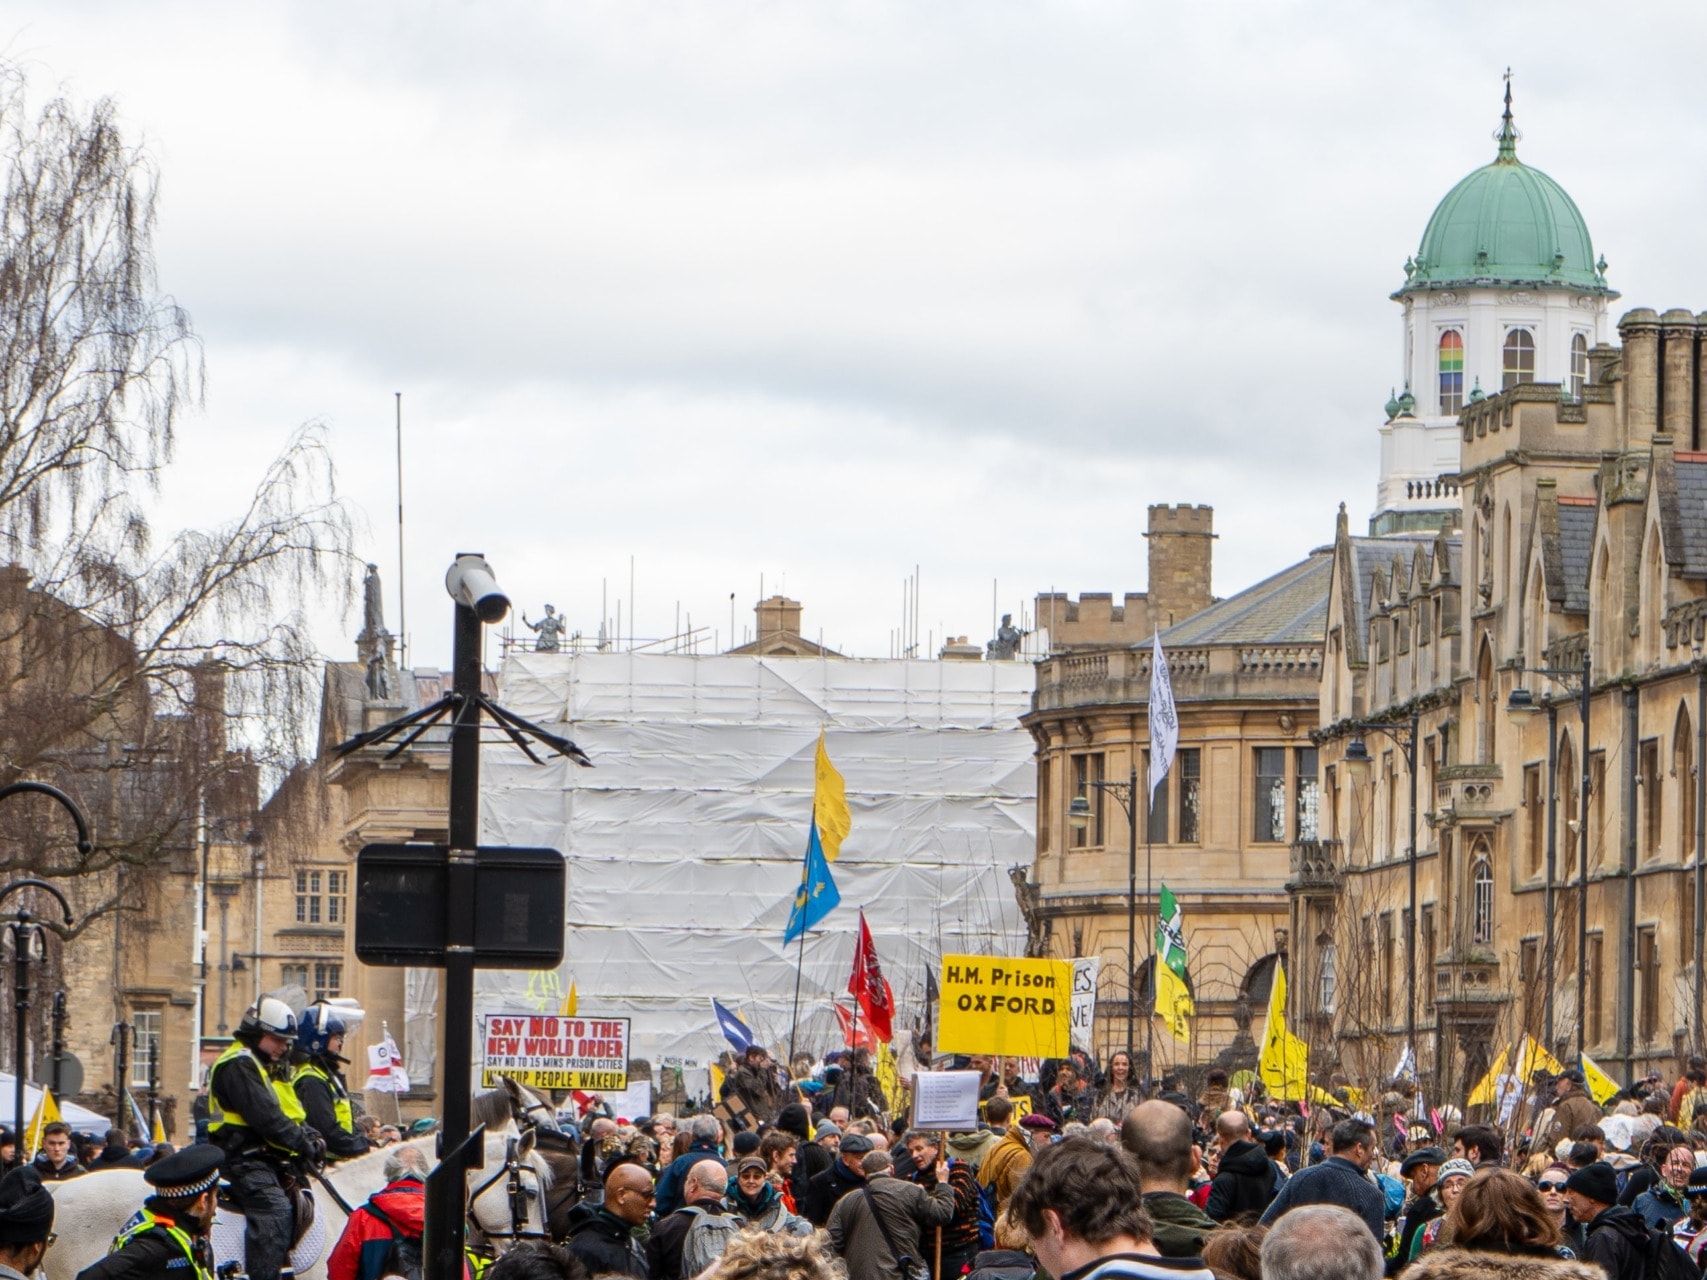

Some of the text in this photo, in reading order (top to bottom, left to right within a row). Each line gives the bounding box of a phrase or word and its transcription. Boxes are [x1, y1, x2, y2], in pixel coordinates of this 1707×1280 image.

[947, 966, 1055, 989] H.M. Prison
[958, 994, 1055, 1015] OXFORD
[491, 1016, 623, 1038] SAY NO TO THE
[488, 1038, 623, 1058] NEW WORLD ORDER
[487, 1056, 623, 1070] SAY NO TO 15 MINS PRISON CITIES
[535, 1071, 573, 1087] PEOPLE
[579, 1072, 623, 1089] WAKEUP
